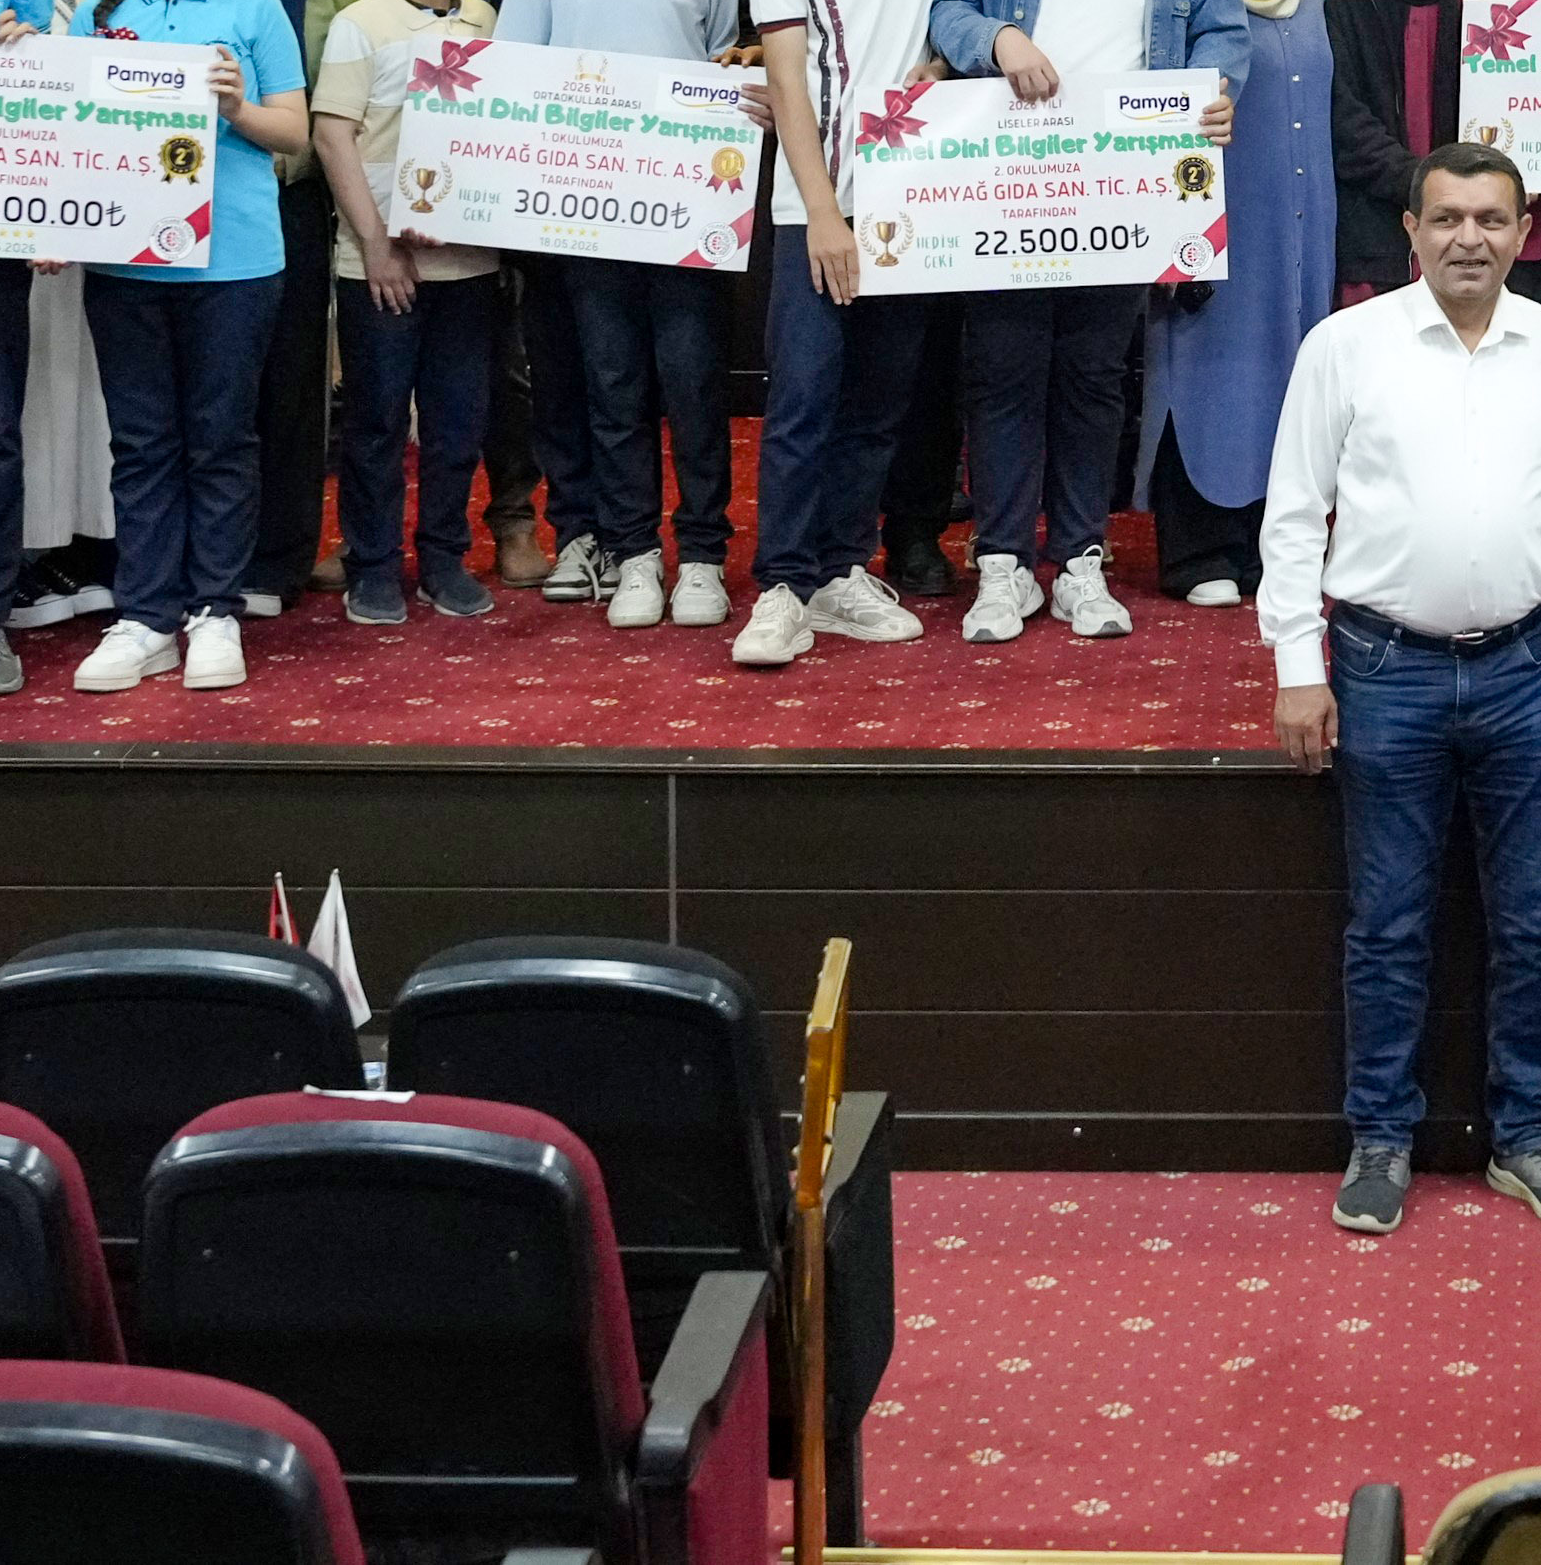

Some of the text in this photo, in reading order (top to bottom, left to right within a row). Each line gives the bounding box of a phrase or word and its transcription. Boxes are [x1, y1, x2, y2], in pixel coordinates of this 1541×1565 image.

[1462, 53, 1537, 74] Temel
[107, 64, 185, 88] Pamyağ
[671, 81, 740, 106] Pamyağ
[1119, 92, 1190, 113] Pamyağ
[75, 100, 208, 130] Yarışması
[406, 91, 484, 118] Temel
[490, 97, 539, 123] Dini
[545, 104, 634, 132] Bilgiler
[449, 139, 530, 163] PAMYAĞ
[536, 149, 579, 168] GIDA
[859, 142, 934, 163] Temel
[940, 137, 990, 160] Dini
[995, 134, 1087, 160] Bilgiler
[906, 181, 987, 203] PAMYAĞ
[994, 183, 1038, 201] GIDA
[1010, 272, 1072, 284] 18.05.2026
